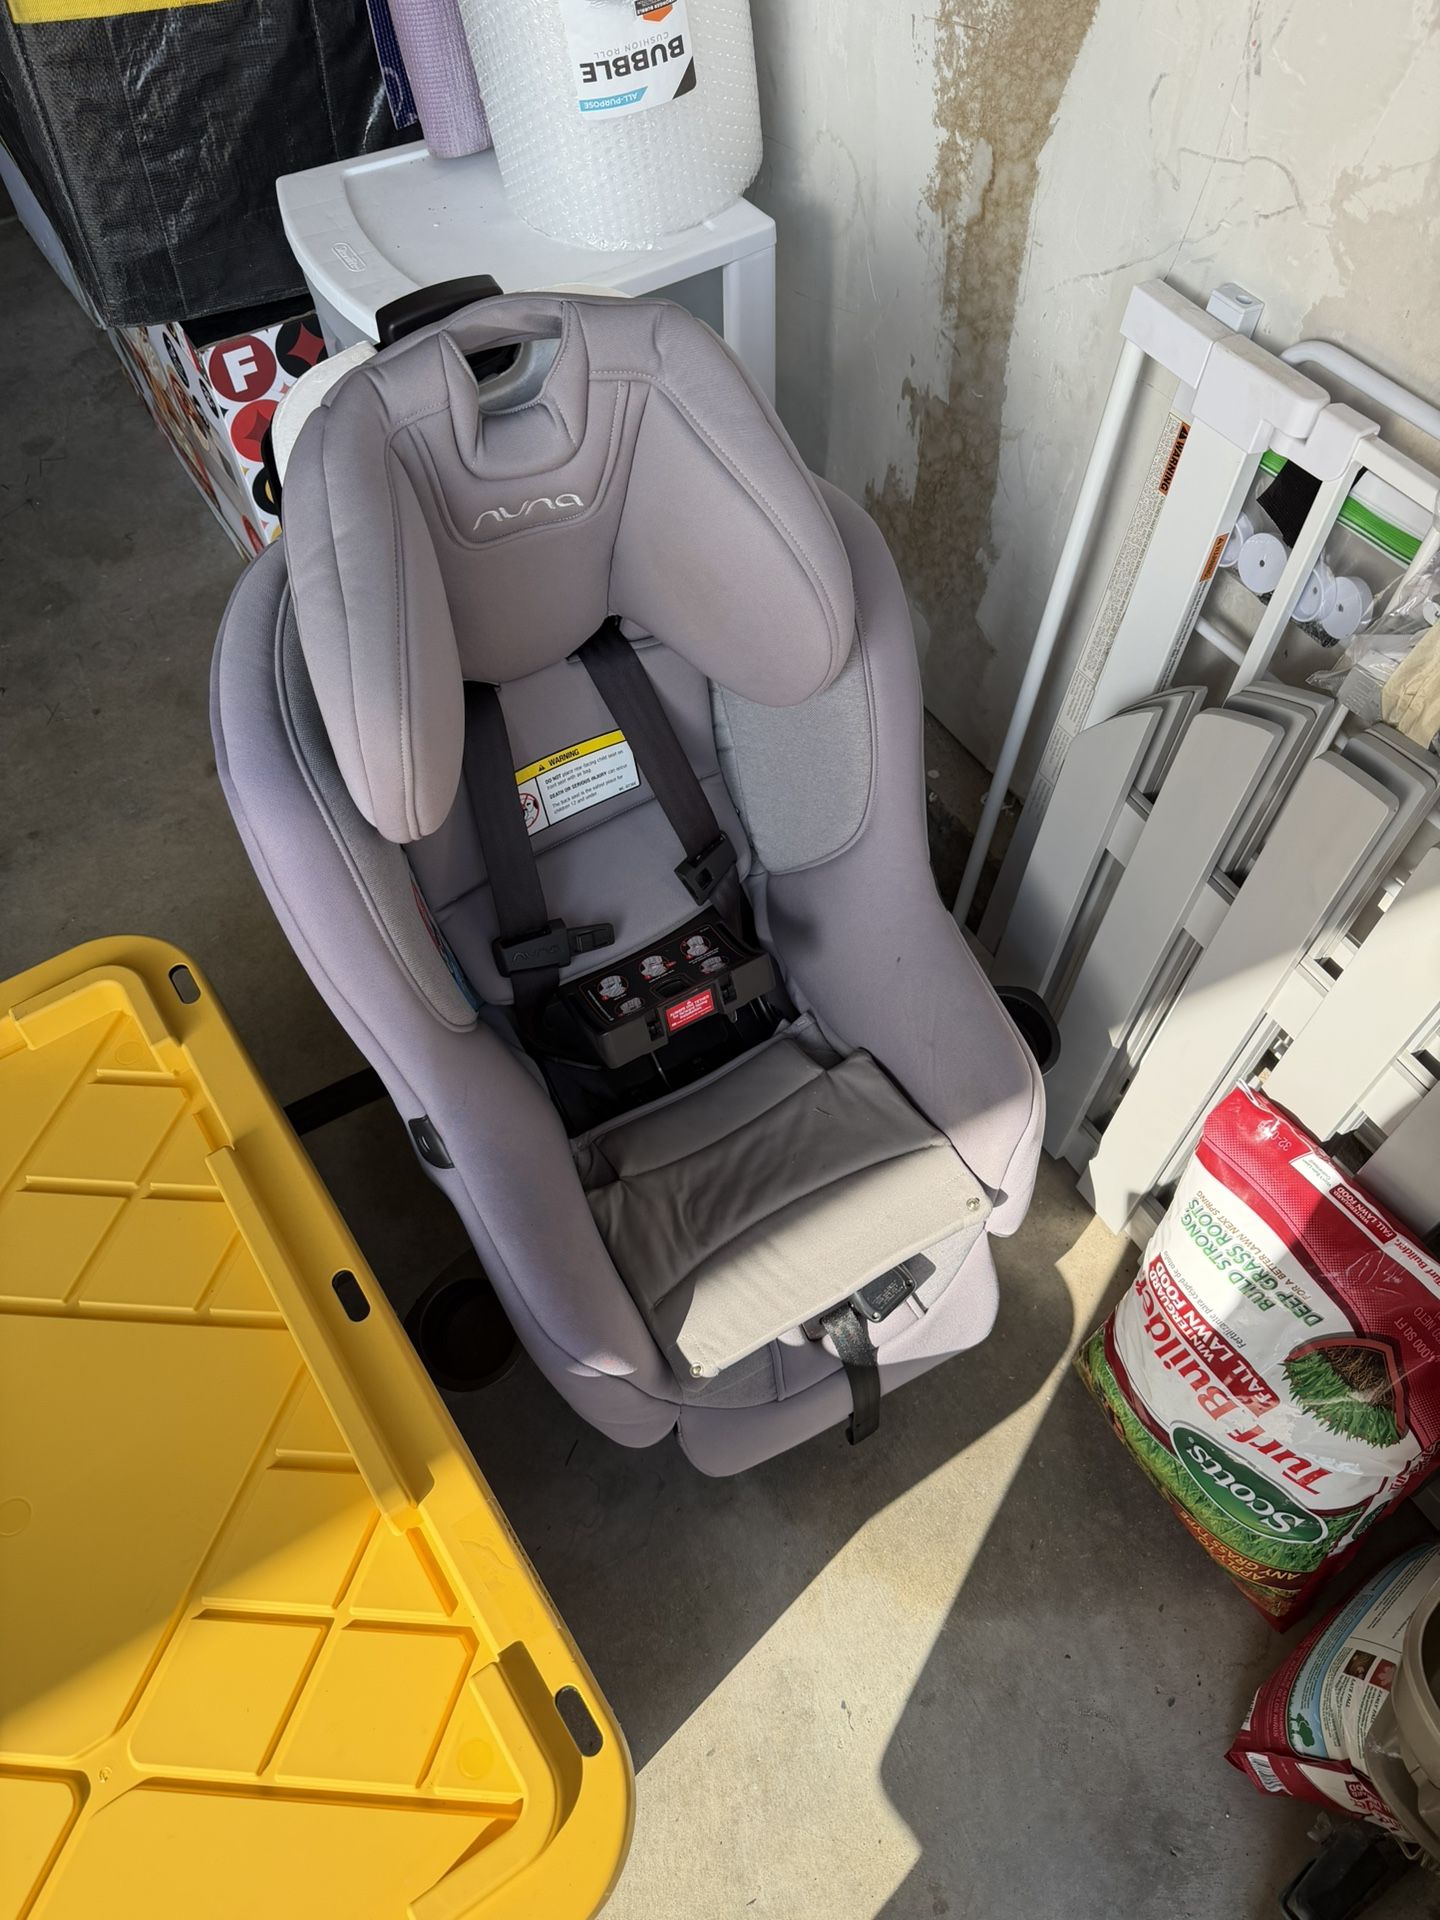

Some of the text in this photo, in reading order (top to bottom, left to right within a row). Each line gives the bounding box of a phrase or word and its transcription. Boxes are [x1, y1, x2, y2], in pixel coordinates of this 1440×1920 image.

[580, 34, 684, 83] BUBBLE
[594, 32, 669, 58] CUSHION ROLL
[585, 92, 638, 110] ALL-PURPOSE
[222, 345, 259, 393] F
[1160, 440, 1186, 491] WARNING
[473, 493, 584, 531] nuna
[548, 749, 580, 767] WARNING
[548, 789, 564, 799] DEATH
[570, 777, 591, 789] SERIOUS
[590, 771, 607, 781] INJURY
[551, 773, 562, 781] NOT
[1196, 1190, 1220, 1216] SPRING
[1337, 1186, 1394, 1238] FALL LAWN FOOD
[1218, 1214, 1238, 1233] NEXT
[1236, 1232, 1262, 1255] LAWN
[1394, 1242, 1428, 1270] Builder
[1174, 1270, 1182, 1280] de
[1189, 1199, 1324, 1327] DEEP GRASS ROOTS
[1259, 1254, 1288, 1280] BETTER
[1228, 1270, 1276, 1312] BUILD
[1294, 1287, 1312, 1301] FOR
[1150, 1270, 1214, 1362] WINTERGUARD
[1197, 1299, 1212, 1315] para
[1414, 1306, 1436, 1330] NETO
[1156, 1261, 1272, 1404] FALL LAWN FOOD
[1210, 1313, 1247, 1348] Fertilizante
[1394, 1317, 1408, 1330] FT
[1404, 1326, 1417, 1342] SQ
[1413, 1339, 1440, 1361] ,000
[1135, 1279, 1333, 1495] Turf Builder
[1186, 1444, 1306, 1533] Scotts
[1180, 1510, 1300, 1580] ANY GRASS TYPE
[1198, 1536, 1266, 1580] APPLY TO
[1345, 1678, 1357, 1708] LATE FALL
[1374, 1690, 1383, 1708] EARLY
